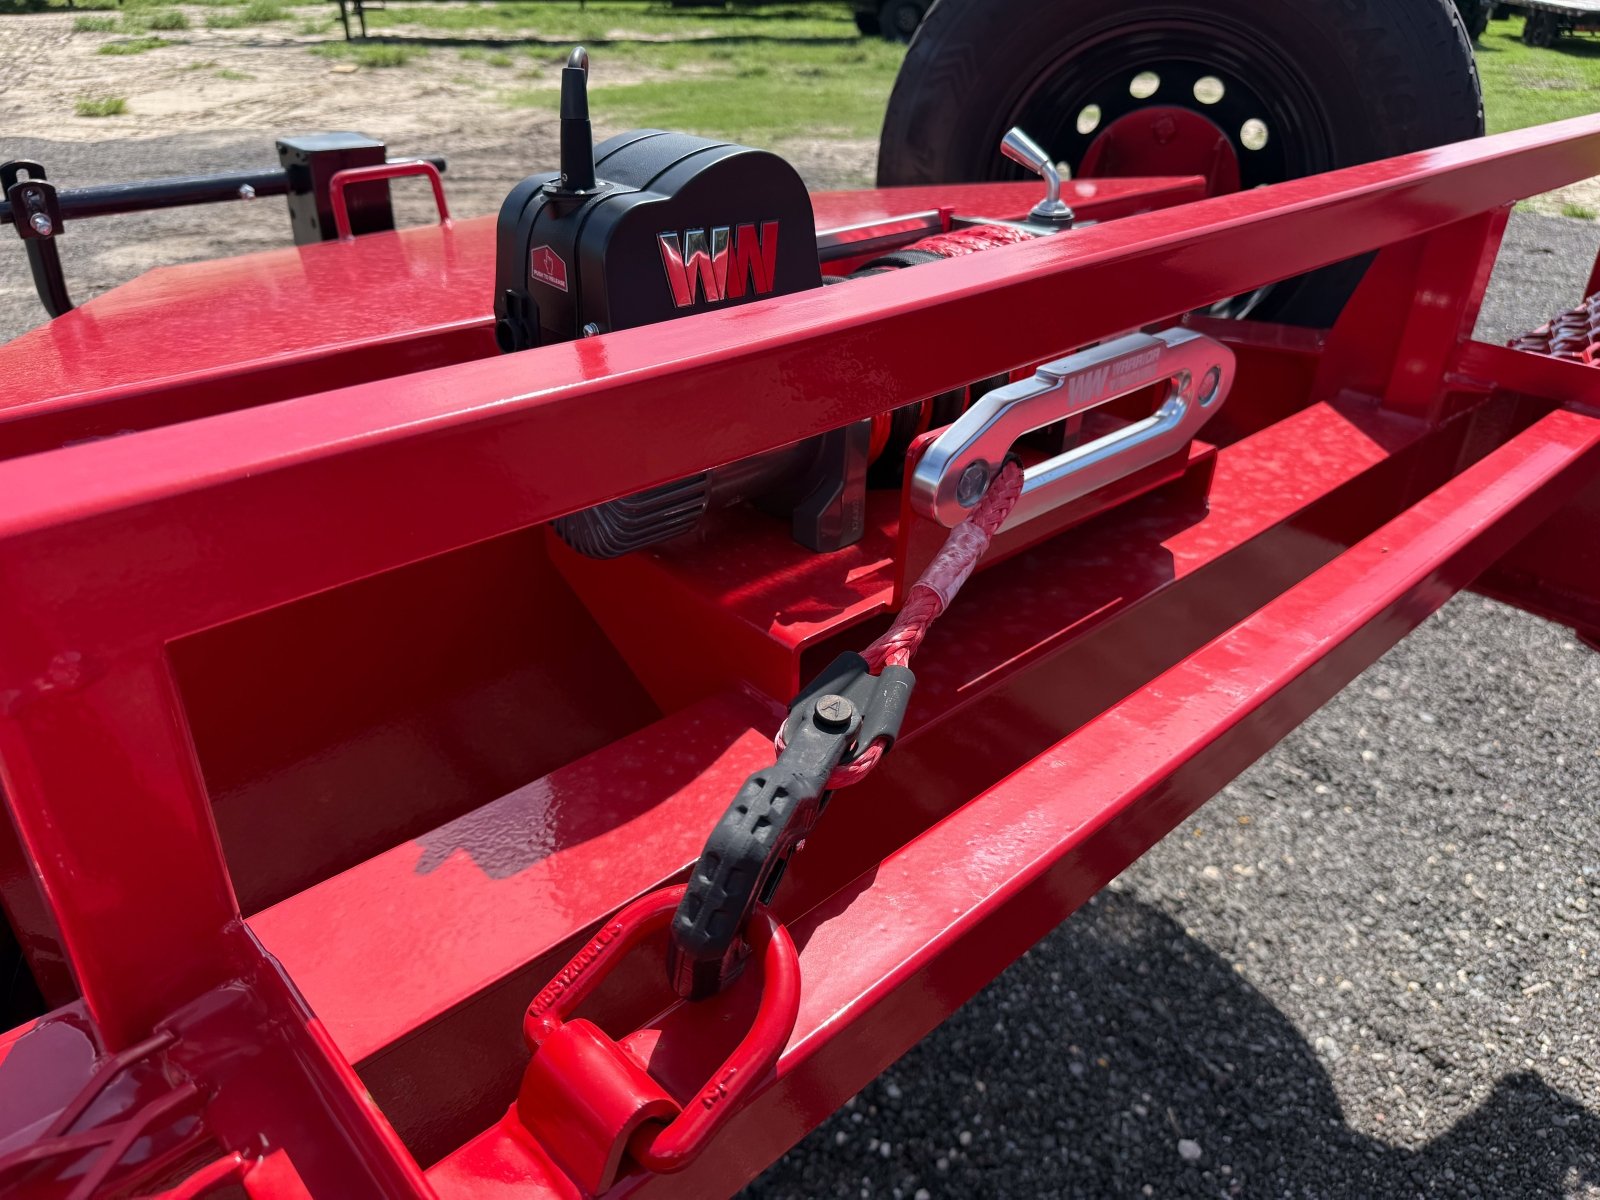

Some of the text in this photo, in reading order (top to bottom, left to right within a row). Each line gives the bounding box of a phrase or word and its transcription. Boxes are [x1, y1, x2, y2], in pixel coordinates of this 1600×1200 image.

[548, 275, 566, 287] RELEASE
[1112, 347, 1161, 377] WARRIOR
[821, 701, 841, 718] A
